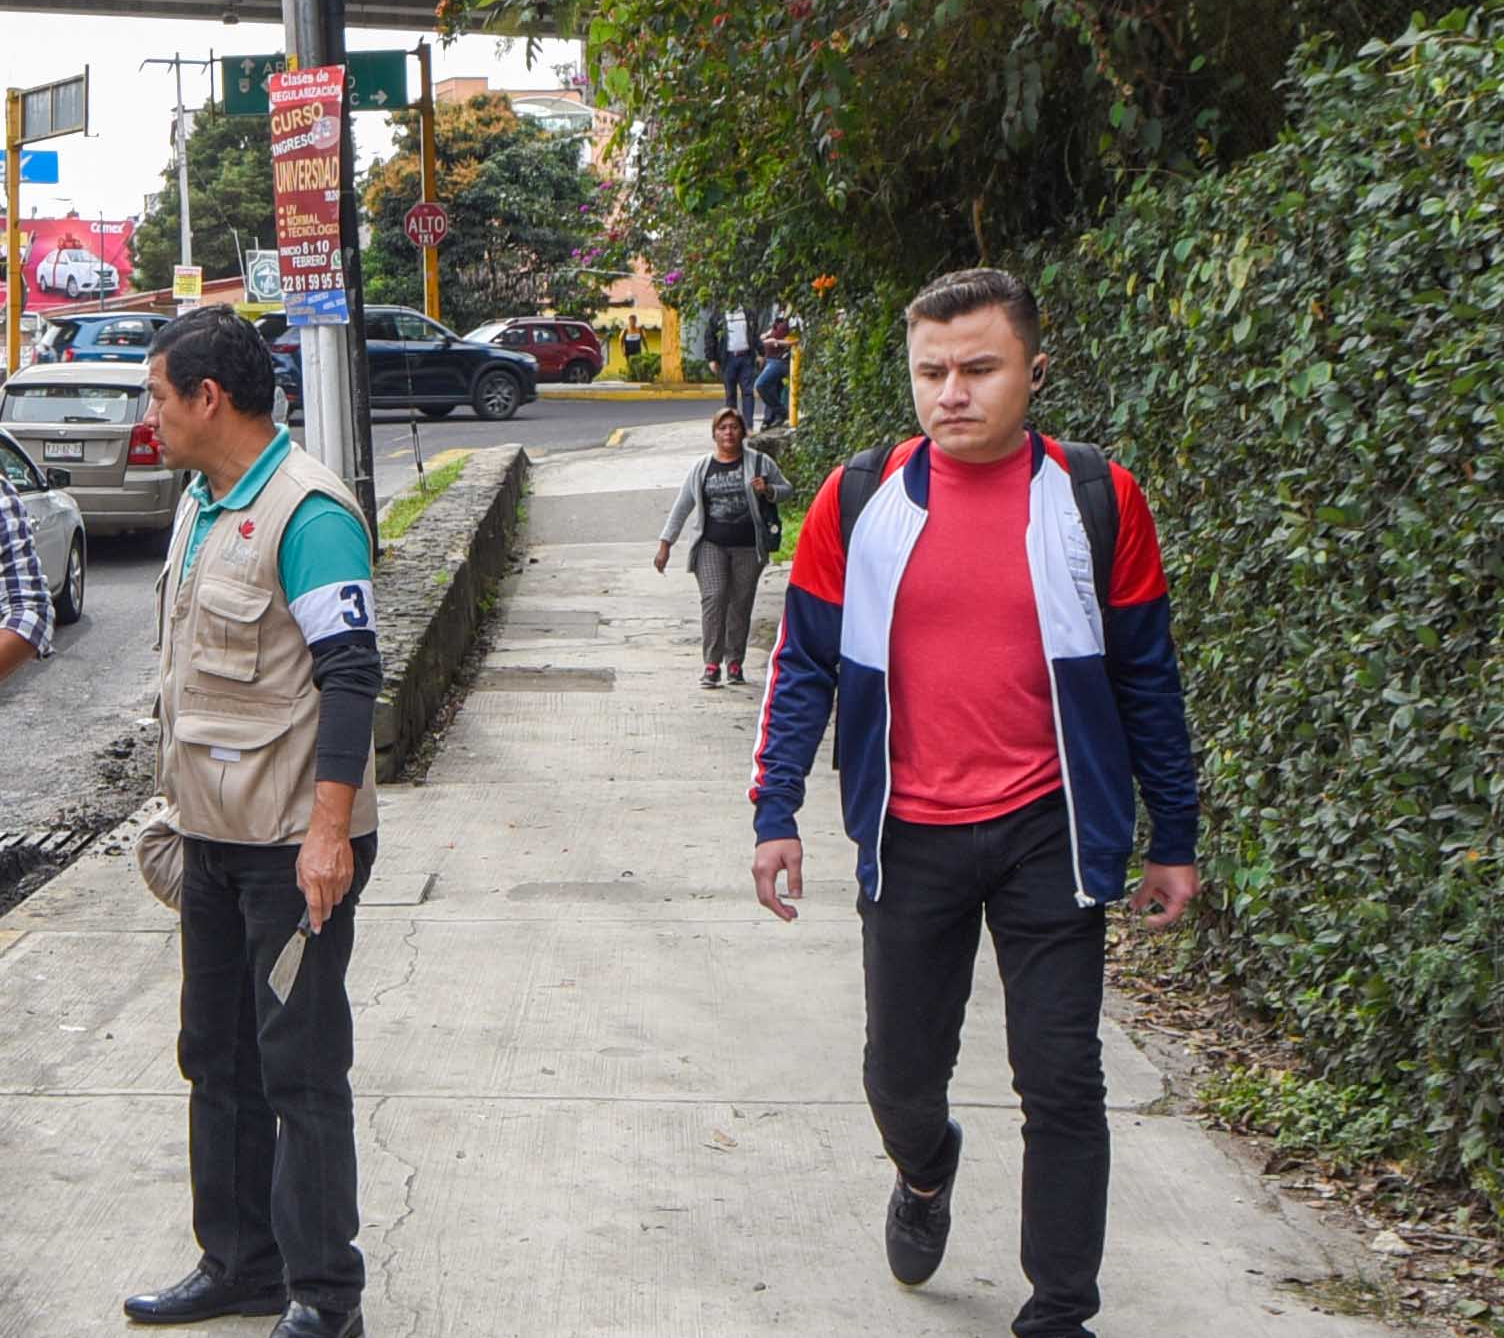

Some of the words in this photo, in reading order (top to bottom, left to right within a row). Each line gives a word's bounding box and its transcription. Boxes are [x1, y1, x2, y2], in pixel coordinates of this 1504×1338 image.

[280, 72, 314, 87] Clases
[316, 69, 329, 82] de
[271, 101, 324, 136] CURSO
[271, 131, 315, 157] INGRESO
[287, 215, 320, 226] NORMAL
[407, 215, 445, 235] ALTO
[302, 242, 309, 254] 8
[316, 240, 330, 253] 10
[292, 255, 327, 269] FEBRERO
[282, 276, 294, 291] 22
[295, 275, 306, 291] 81
[308, 274, 320, 291] 59
[321, 273, 333, 289] 95
[339, 584, 369, 627] 3
